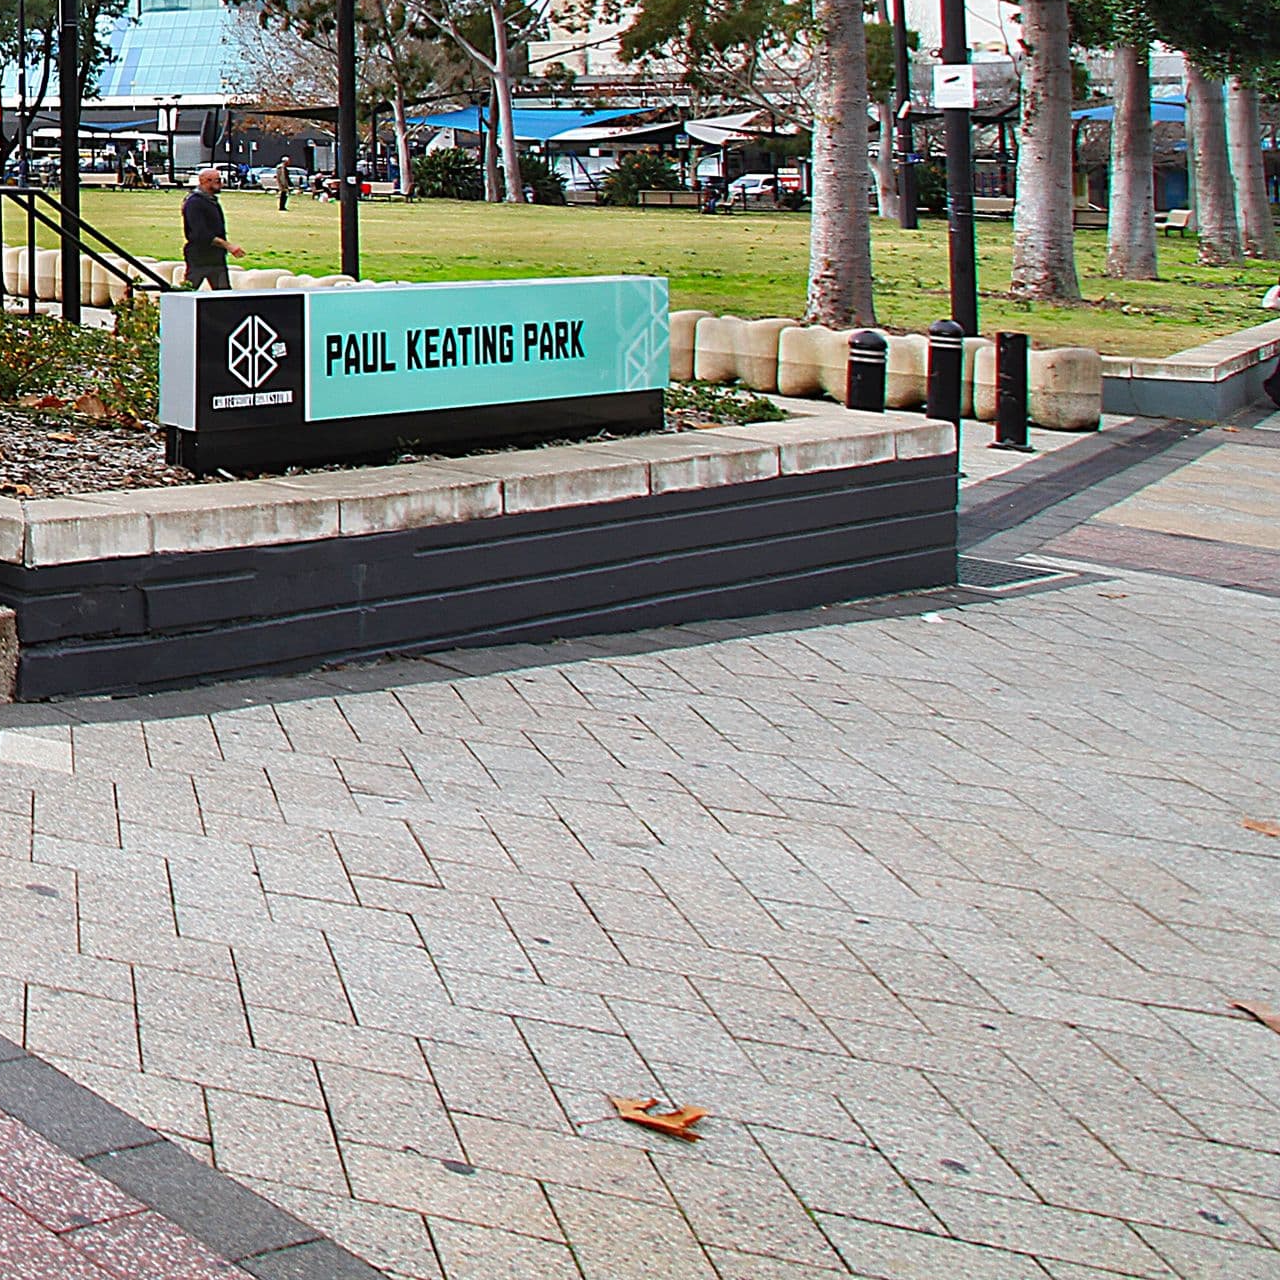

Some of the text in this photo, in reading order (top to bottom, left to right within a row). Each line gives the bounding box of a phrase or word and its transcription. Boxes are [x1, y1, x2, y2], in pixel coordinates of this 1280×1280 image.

[326, 320, 585, 376] PAUL KEATING PARK
